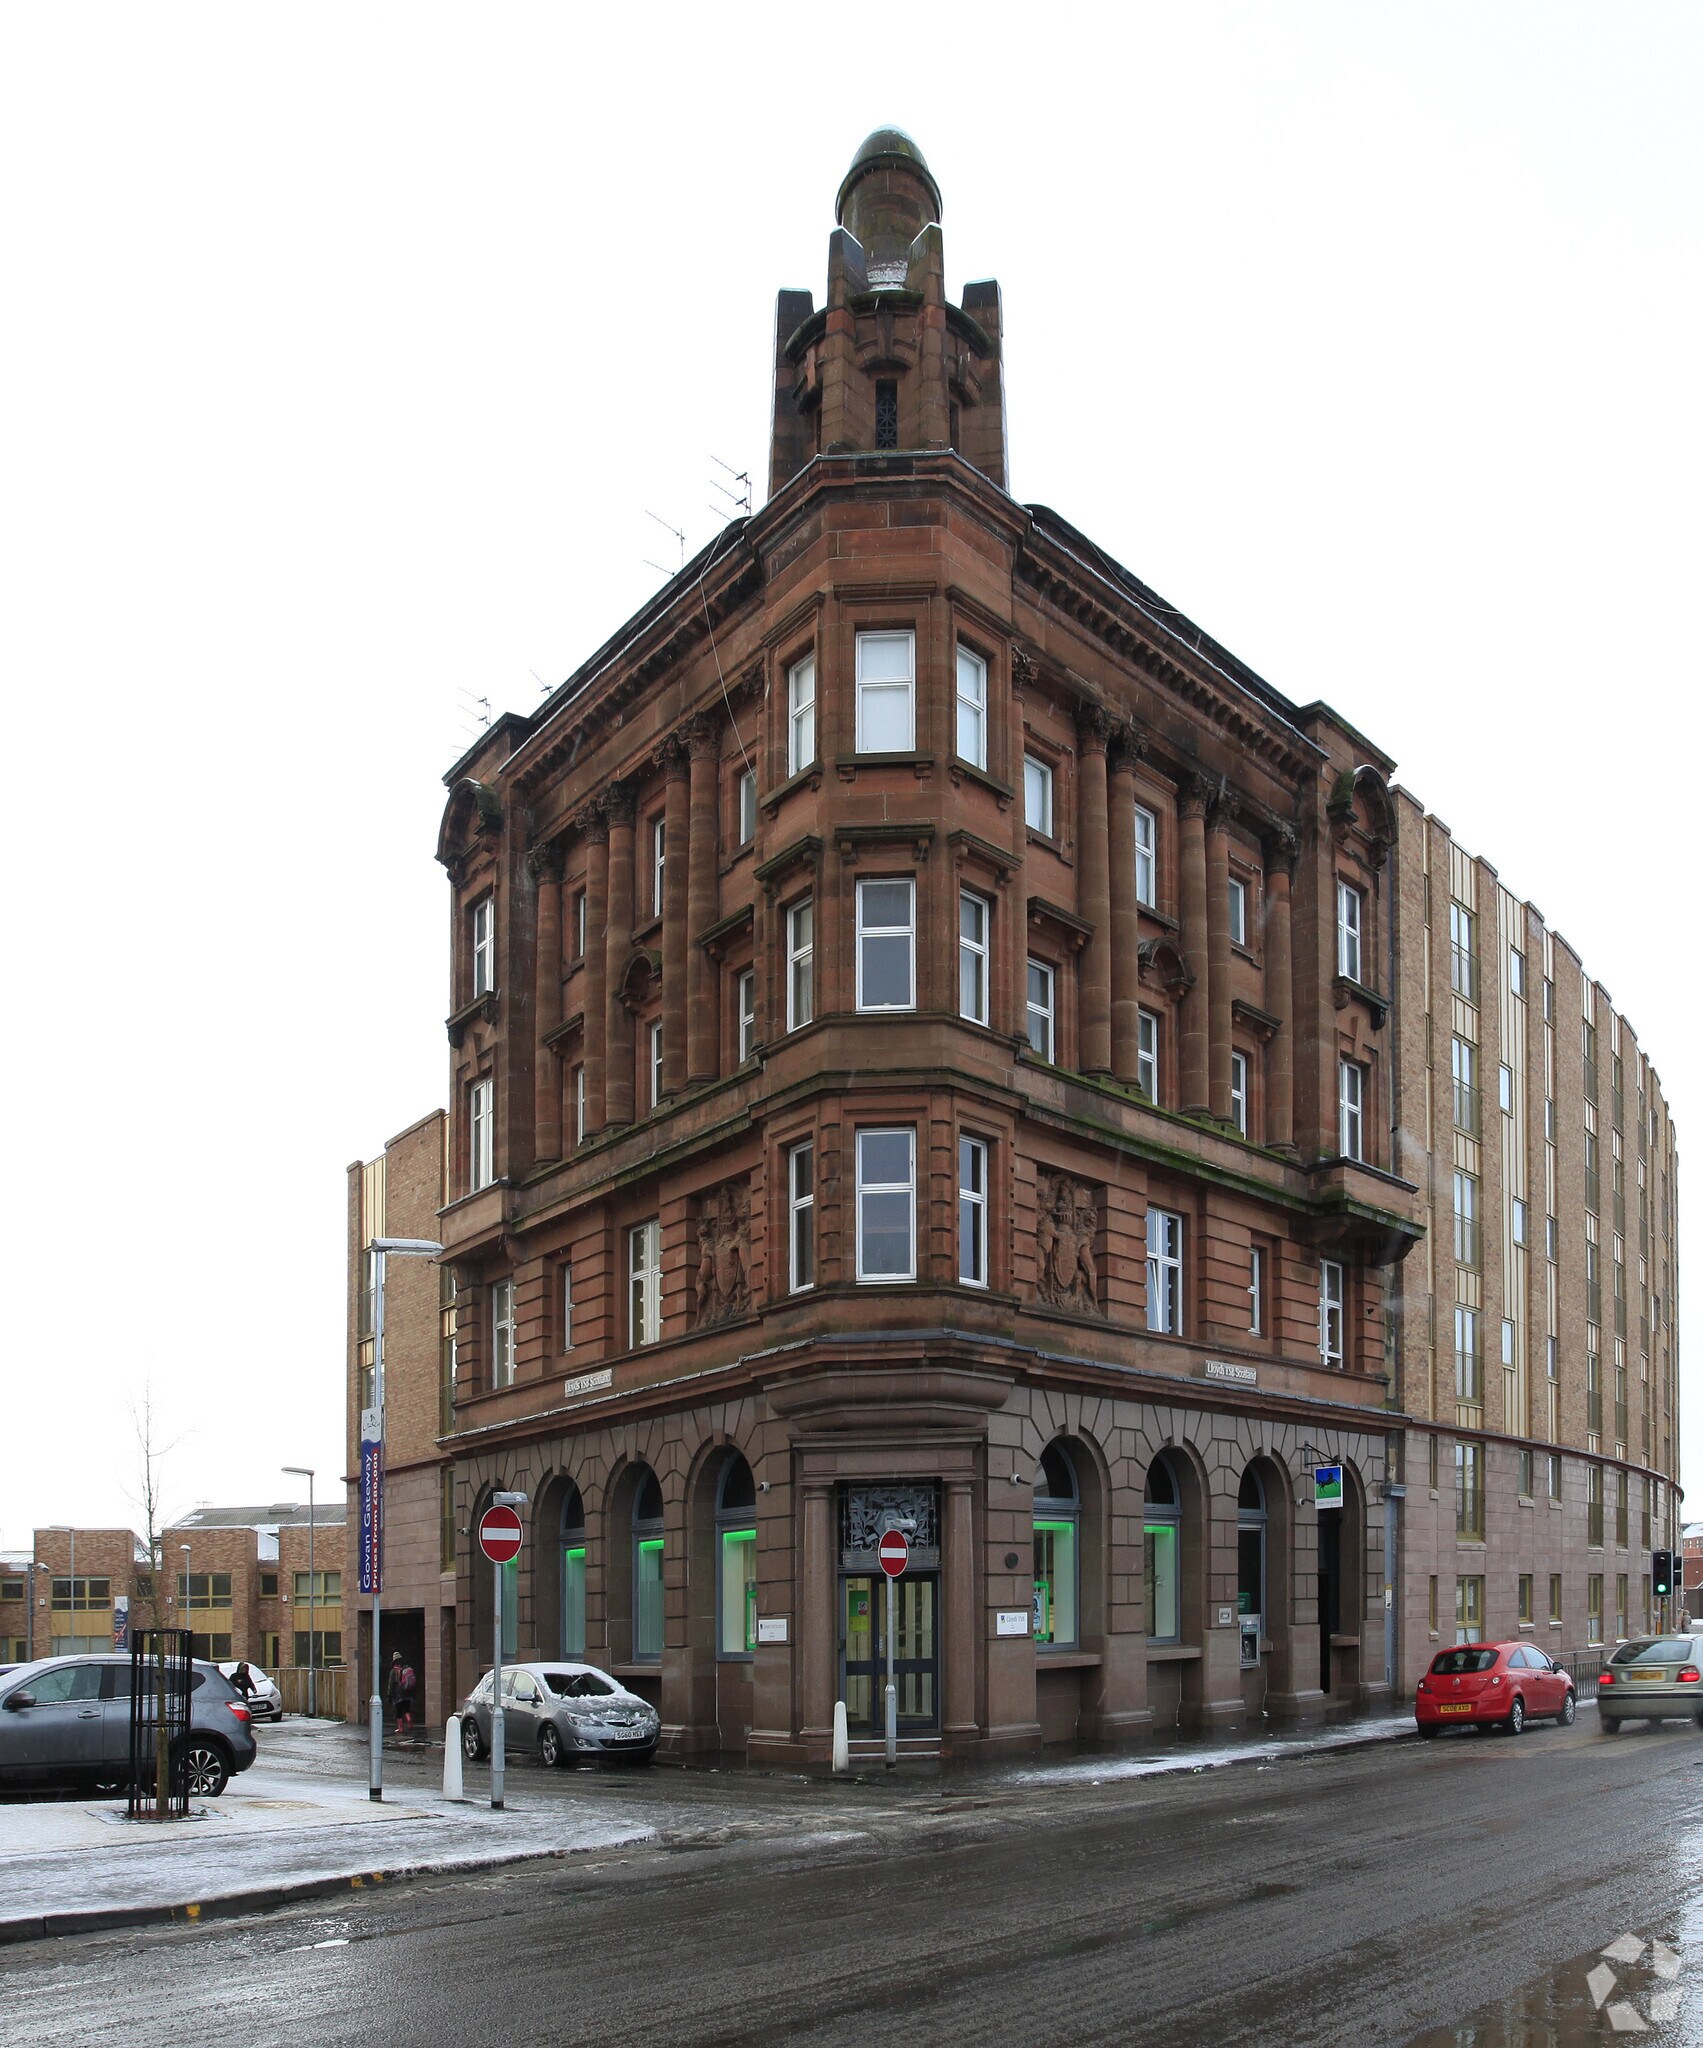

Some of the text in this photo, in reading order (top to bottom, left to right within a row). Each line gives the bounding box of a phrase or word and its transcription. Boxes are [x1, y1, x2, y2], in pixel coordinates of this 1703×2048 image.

[1207, 1362, 1225, 1377] Lloyds
[1235, 1367, 1257, 1381] Scotland
[363, 1453, 372, 1589] Govan Gateway
